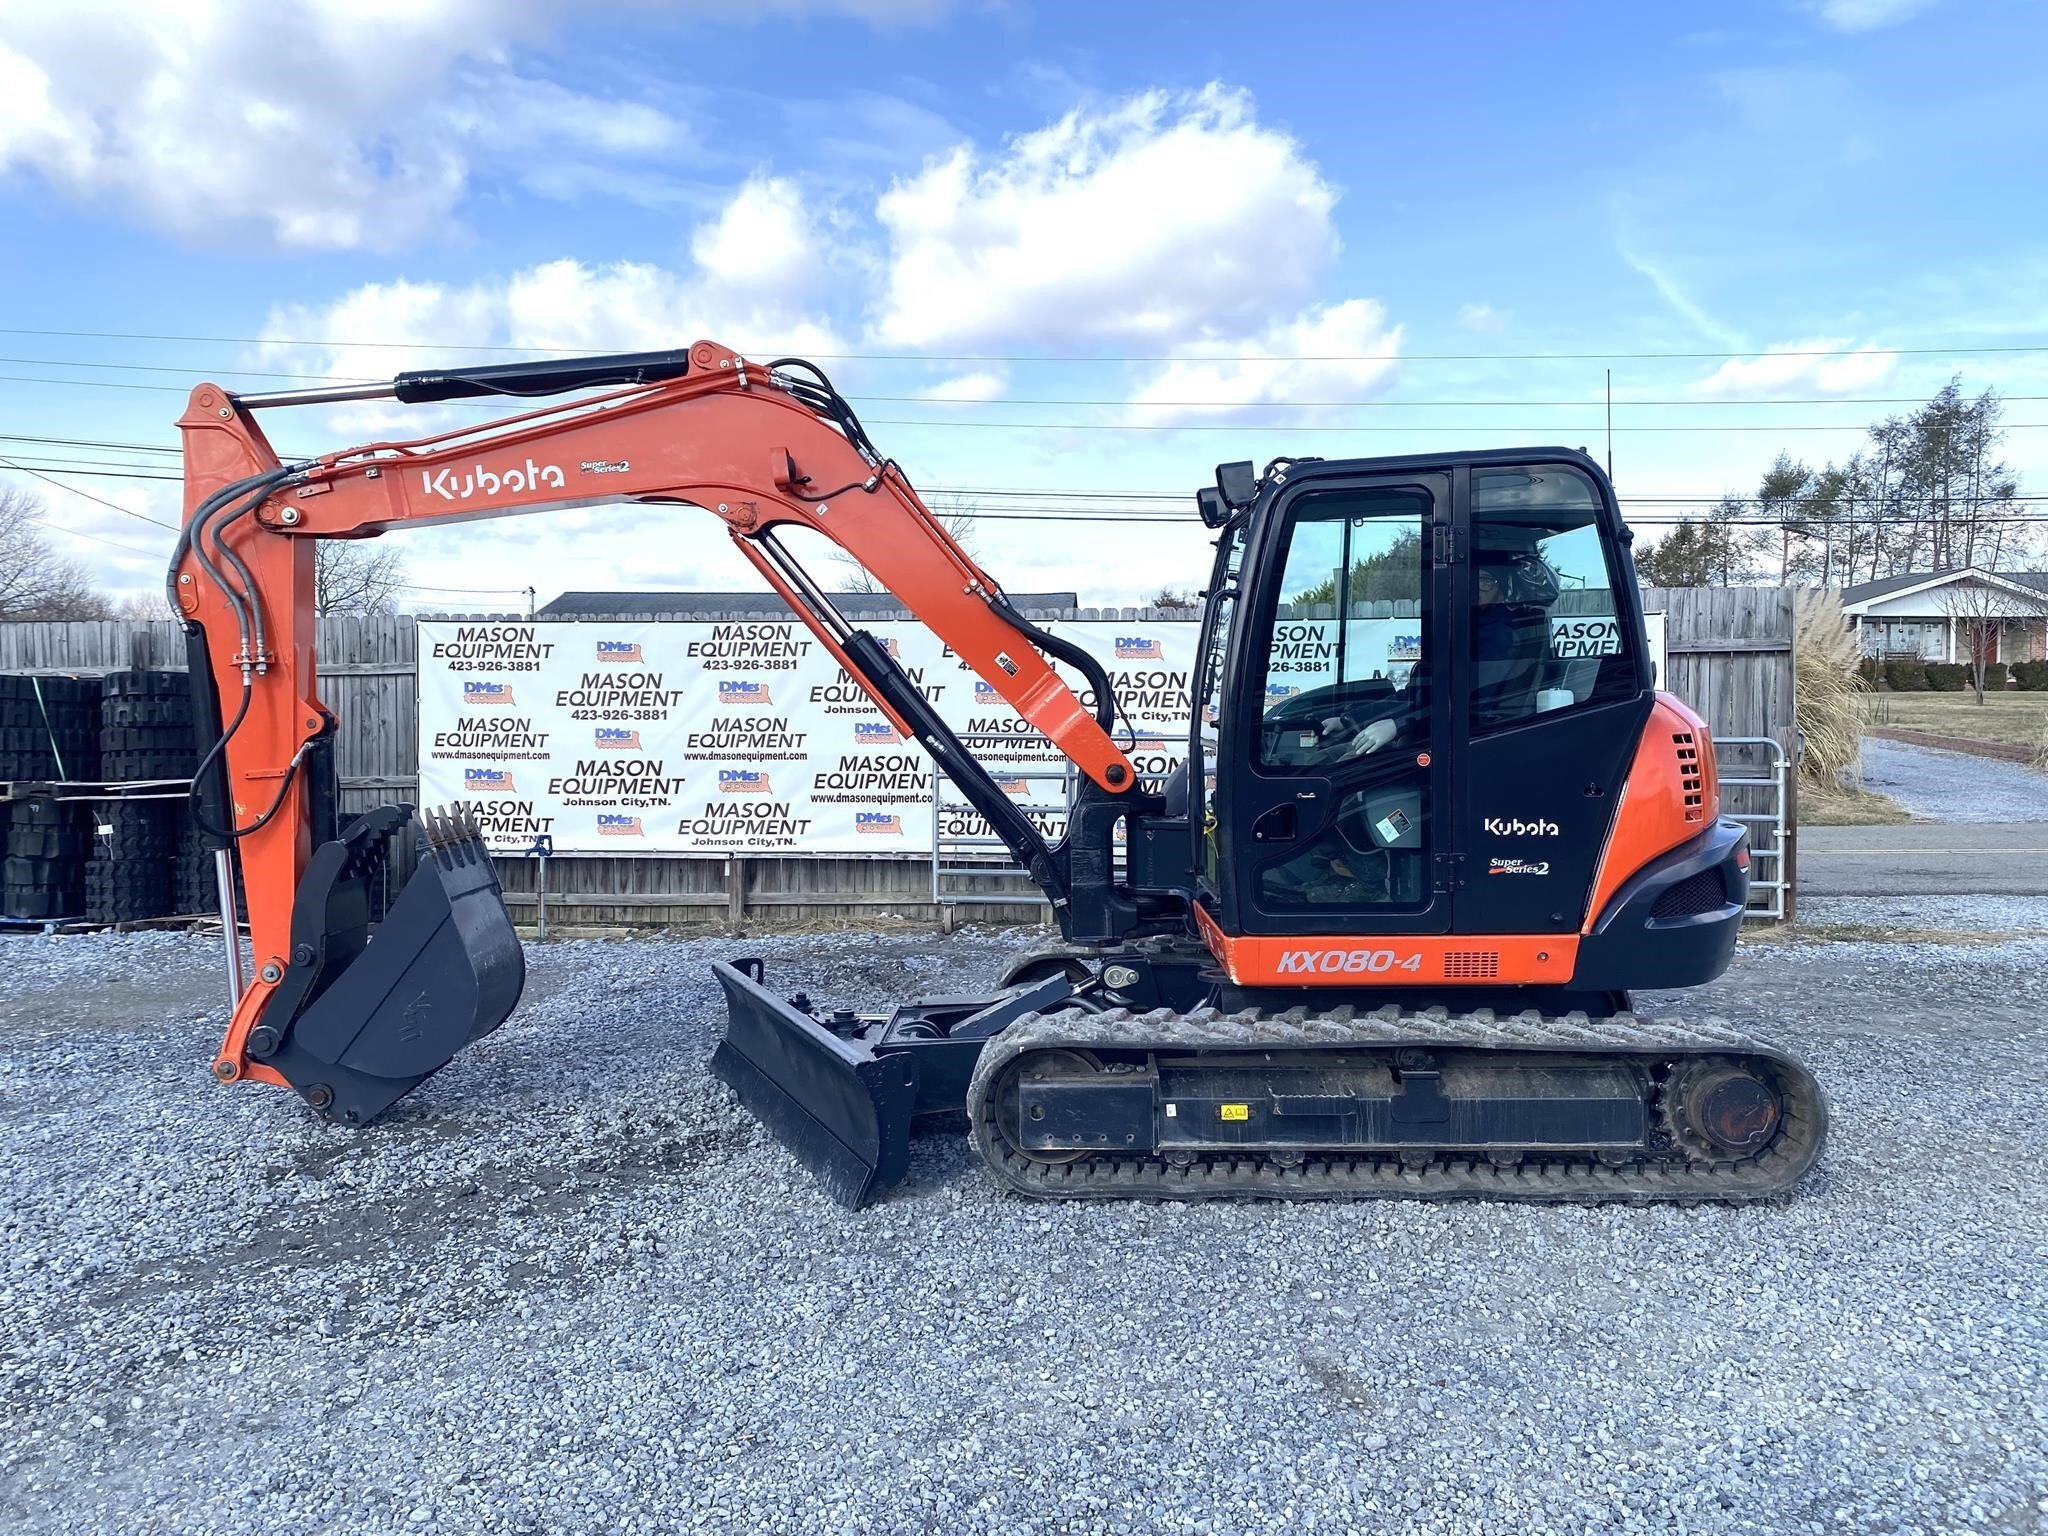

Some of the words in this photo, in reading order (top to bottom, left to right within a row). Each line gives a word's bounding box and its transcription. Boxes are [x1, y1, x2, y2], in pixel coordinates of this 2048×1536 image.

[580, 460, 608, 471] Super
[422, 459, 565, 500] Kubota
[457, 627, 536, 643] MASON
[711, 625, 792, 641] MASON
[1272, 625, 1325, 642] SON
[1552, 622, 1620, 640] ASON
[432, 643, 555, 660] EQUIPMENT
[687, 641, 813, 658] EQUIPMENT
[448, 661, 541, 672] 423-926-3881
[702, 659, 798, 671] 423-926-3881
[1268, 661, 1330, 672] 26-3881
[581, 673, 663, 689] MASON
[555, 690, 683, 707] EQUIPMENT
[571, 709, 668, 721] 423-926-3881
[824, 705, 877, 714] Johnson
[1141, 711, 1191, 722] City,TN
[457, 717, 531, 732] MASON
[711, 717, 788, 733] MASON
[434, 733, 550, 749] EQUIPMENT
[687, 733, 808, 749] EQUIPMENT
[431, 750, 550, 762] www.dmasonequipment.com
[684, 751, 808, 763] www.dmasonequipment.com
[839, 755, 920, 772] MASON
[973, 752, 1067, 764] masonequipment.com
[575, 760, 663, 777] MASON
[1133, 756, 1184, 774] SON
[548, 778, 685, 795] EQUIPMENT
[563, 797, 617, 807] Johnson
[621, 797, 672, 808] City,TN.
[810, 791, 932, 805] www.dmasonequipment.co
[705, 803, 791, 818] MASON
[678, 819, 811, 836] EQUIPMENT
[1484, 818, 1559, 836] Kubota
[494, 835, 538, 845] City,TN
[691, 837, 744, 847] Johnson
[748, 837, 797, 848] City,TN.
[1490, 858, 1523, 867] Super
[1276, 950, 1424, 974] KX080-4
